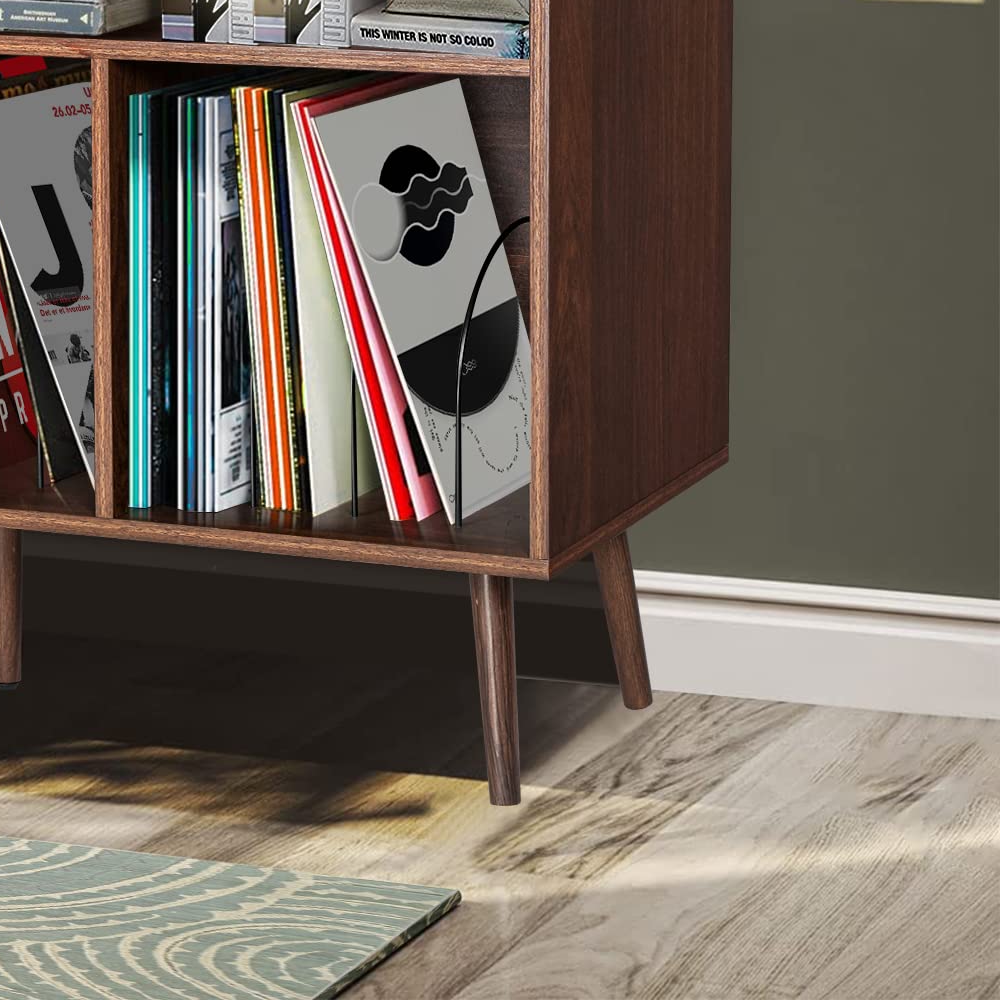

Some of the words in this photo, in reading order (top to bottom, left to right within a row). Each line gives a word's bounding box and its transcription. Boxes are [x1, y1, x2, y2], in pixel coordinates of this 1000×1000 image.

[360, 27, 381, 39] THIS
[382, 29, 417, 42] WINTER
[418, 31, 428, 42] IS
[429, 32, 449, 44] NOT
[450, 34, 464, 45] SO
[464, 34, 495, 48] COLOD
[30, 184, 84, 307] J
